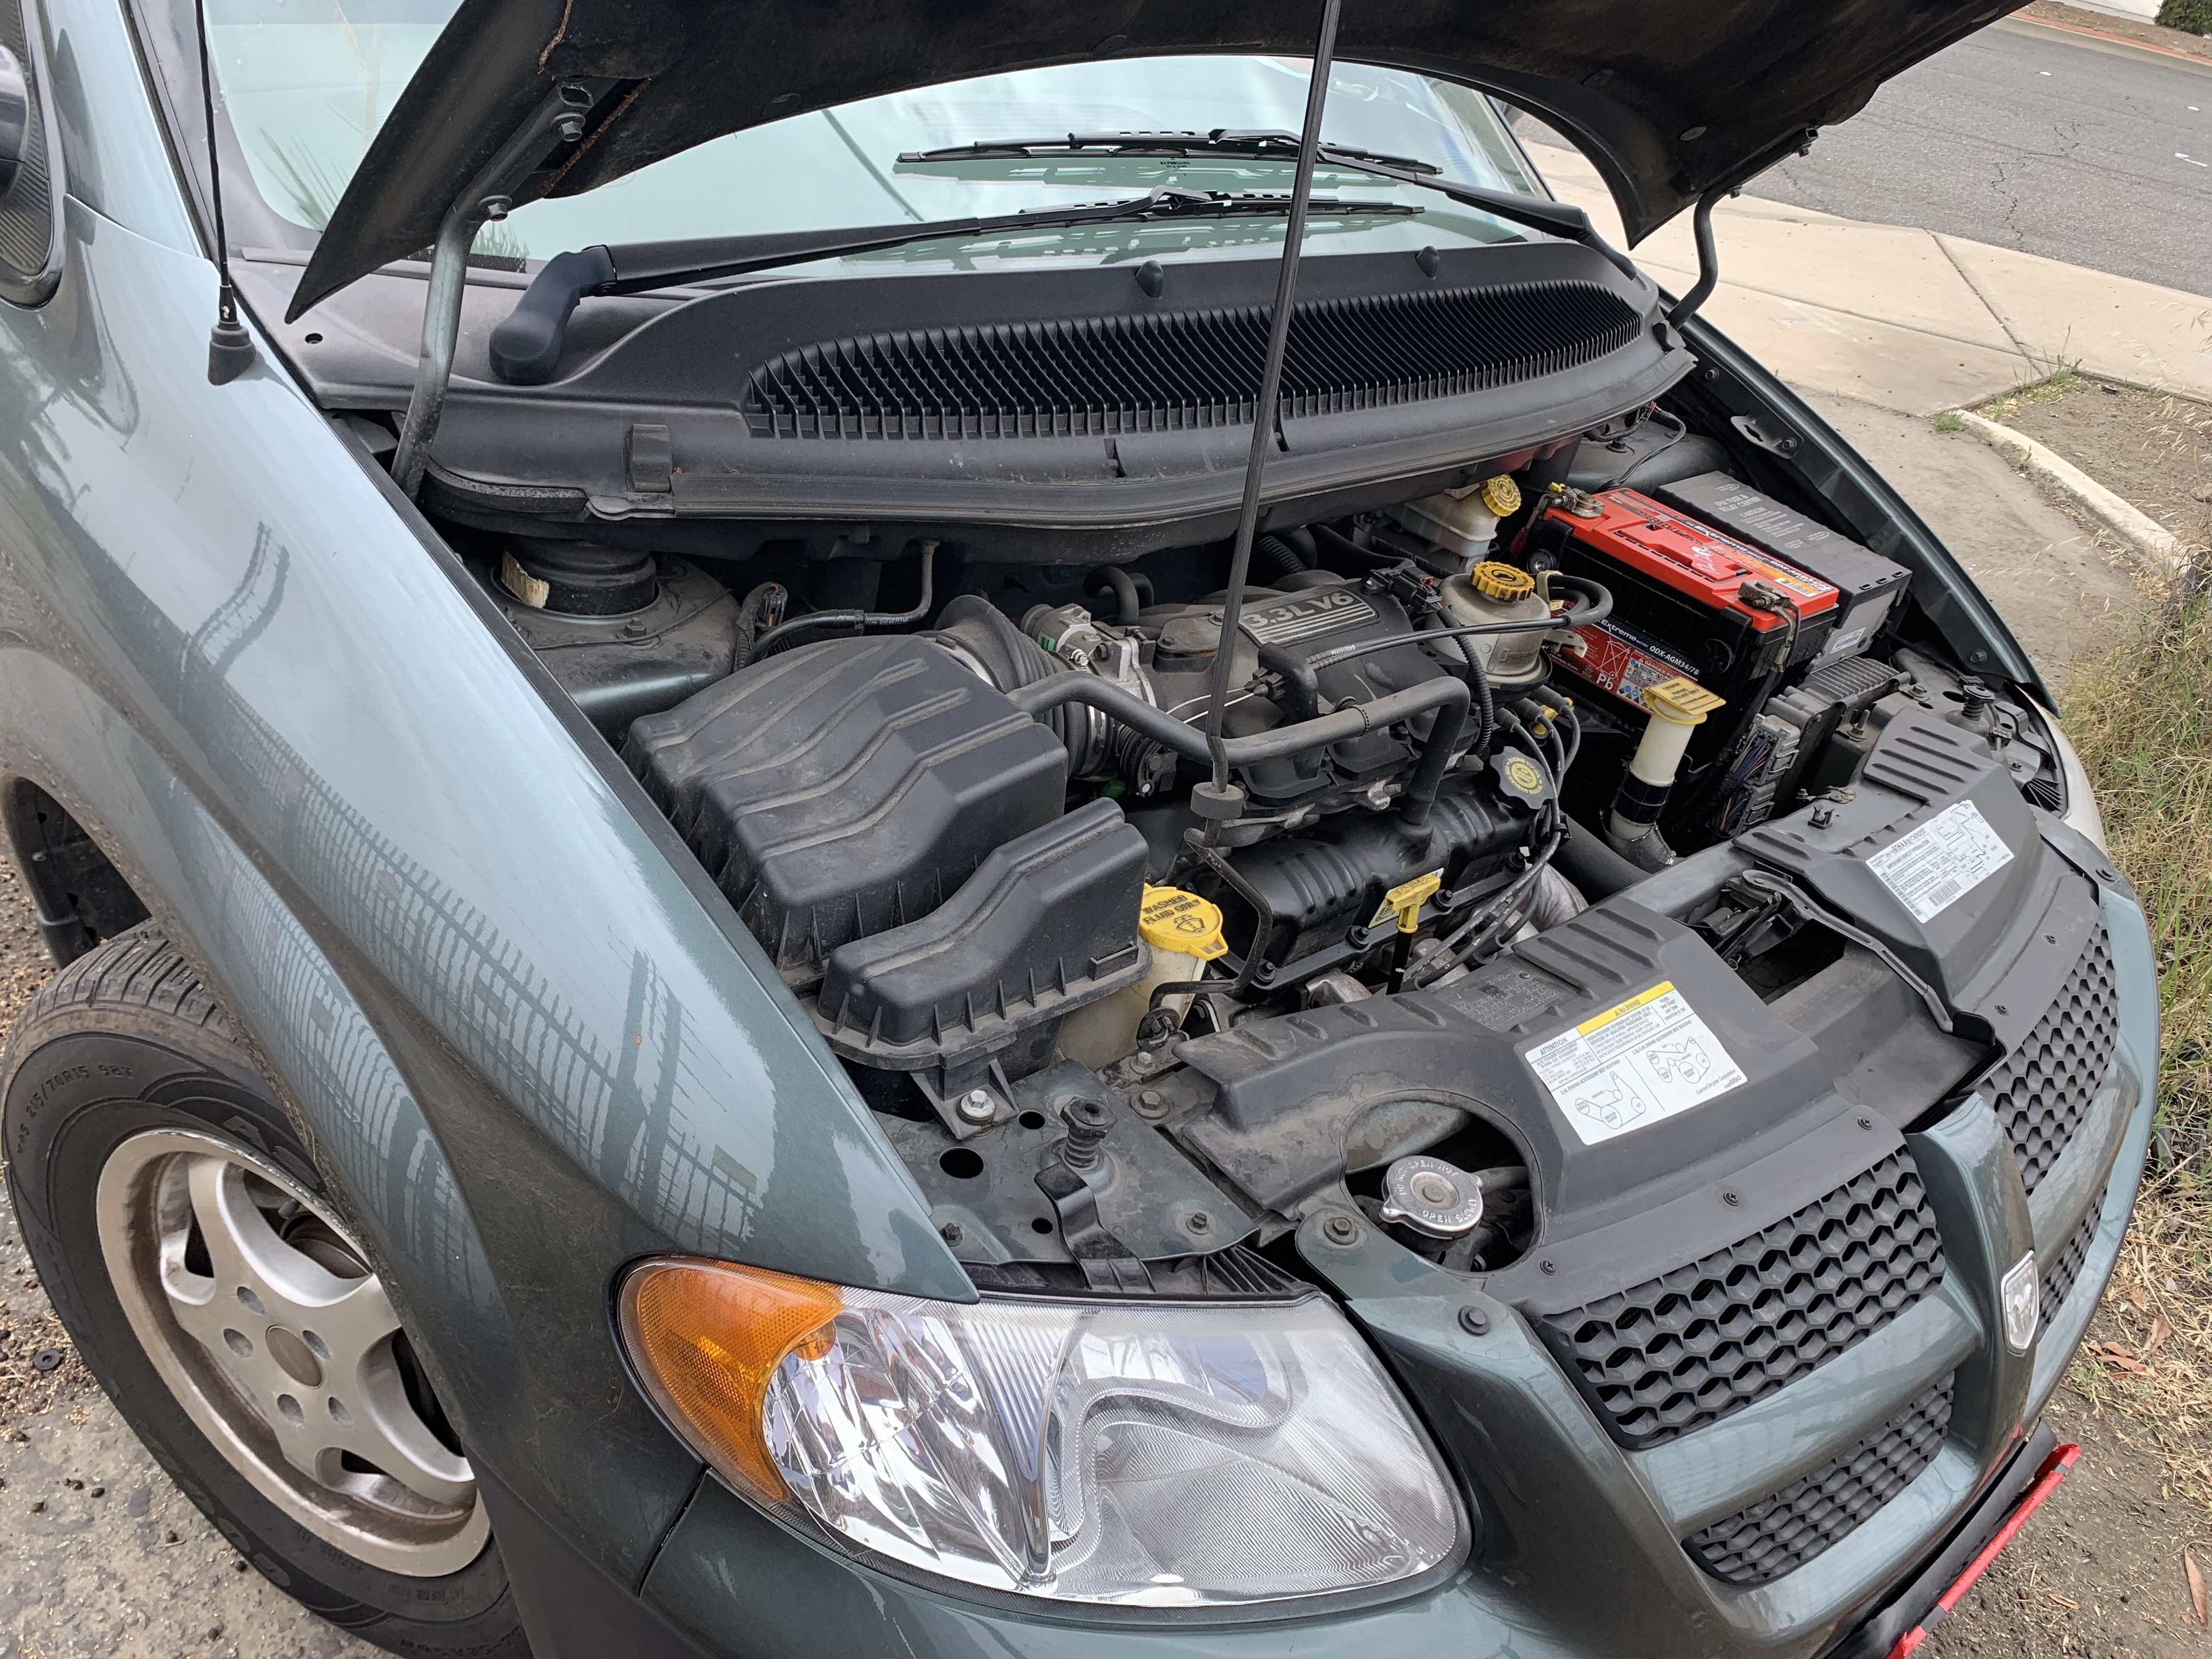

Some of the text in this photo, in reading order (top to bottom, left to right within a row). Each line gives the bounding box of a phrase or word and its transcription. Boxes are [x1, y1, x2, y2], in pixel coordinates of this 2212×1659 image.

[1243, 592, 1354, 627] 3.3L V6
[1601, 618, 1637, 641] Extreme
[1649, 645, 1700, 676] ODX-AGM34/78
[1596, 673, 1613, 690] Pb
[1142, 894, 1188, 914] WASHER
[1143, 899, 1201, 925] FLUID ONLY
[1618, 999, 1641, 1014] WARNING
[1589, 1035, 1605, 1046] SERVICED
[1610, 1024, 1626, 1035] QUALIFIED
[1626, 1015, 1643, 1027] PERSONNEL
[1656, 1029, 1673, 1042] ACCESSORY
[1678, 1020, 1692, 1030] ROUTING
[1539, 1036, 1568, 1056] ATTENTION
[1567, 1082, 1581, 1091] ENGINE
[1579, 1071, 1600, 1085] ACCESSORY
[1605, 1059, 1621, 1070] ROUTING
[1695, 1069, 1736, 1096] DaimlerChrysler Corporation
[1395, 1160, 1459, 1195] DO NOT OPEN HOT
[1422, 1210, 1452, 1223] OPEN
